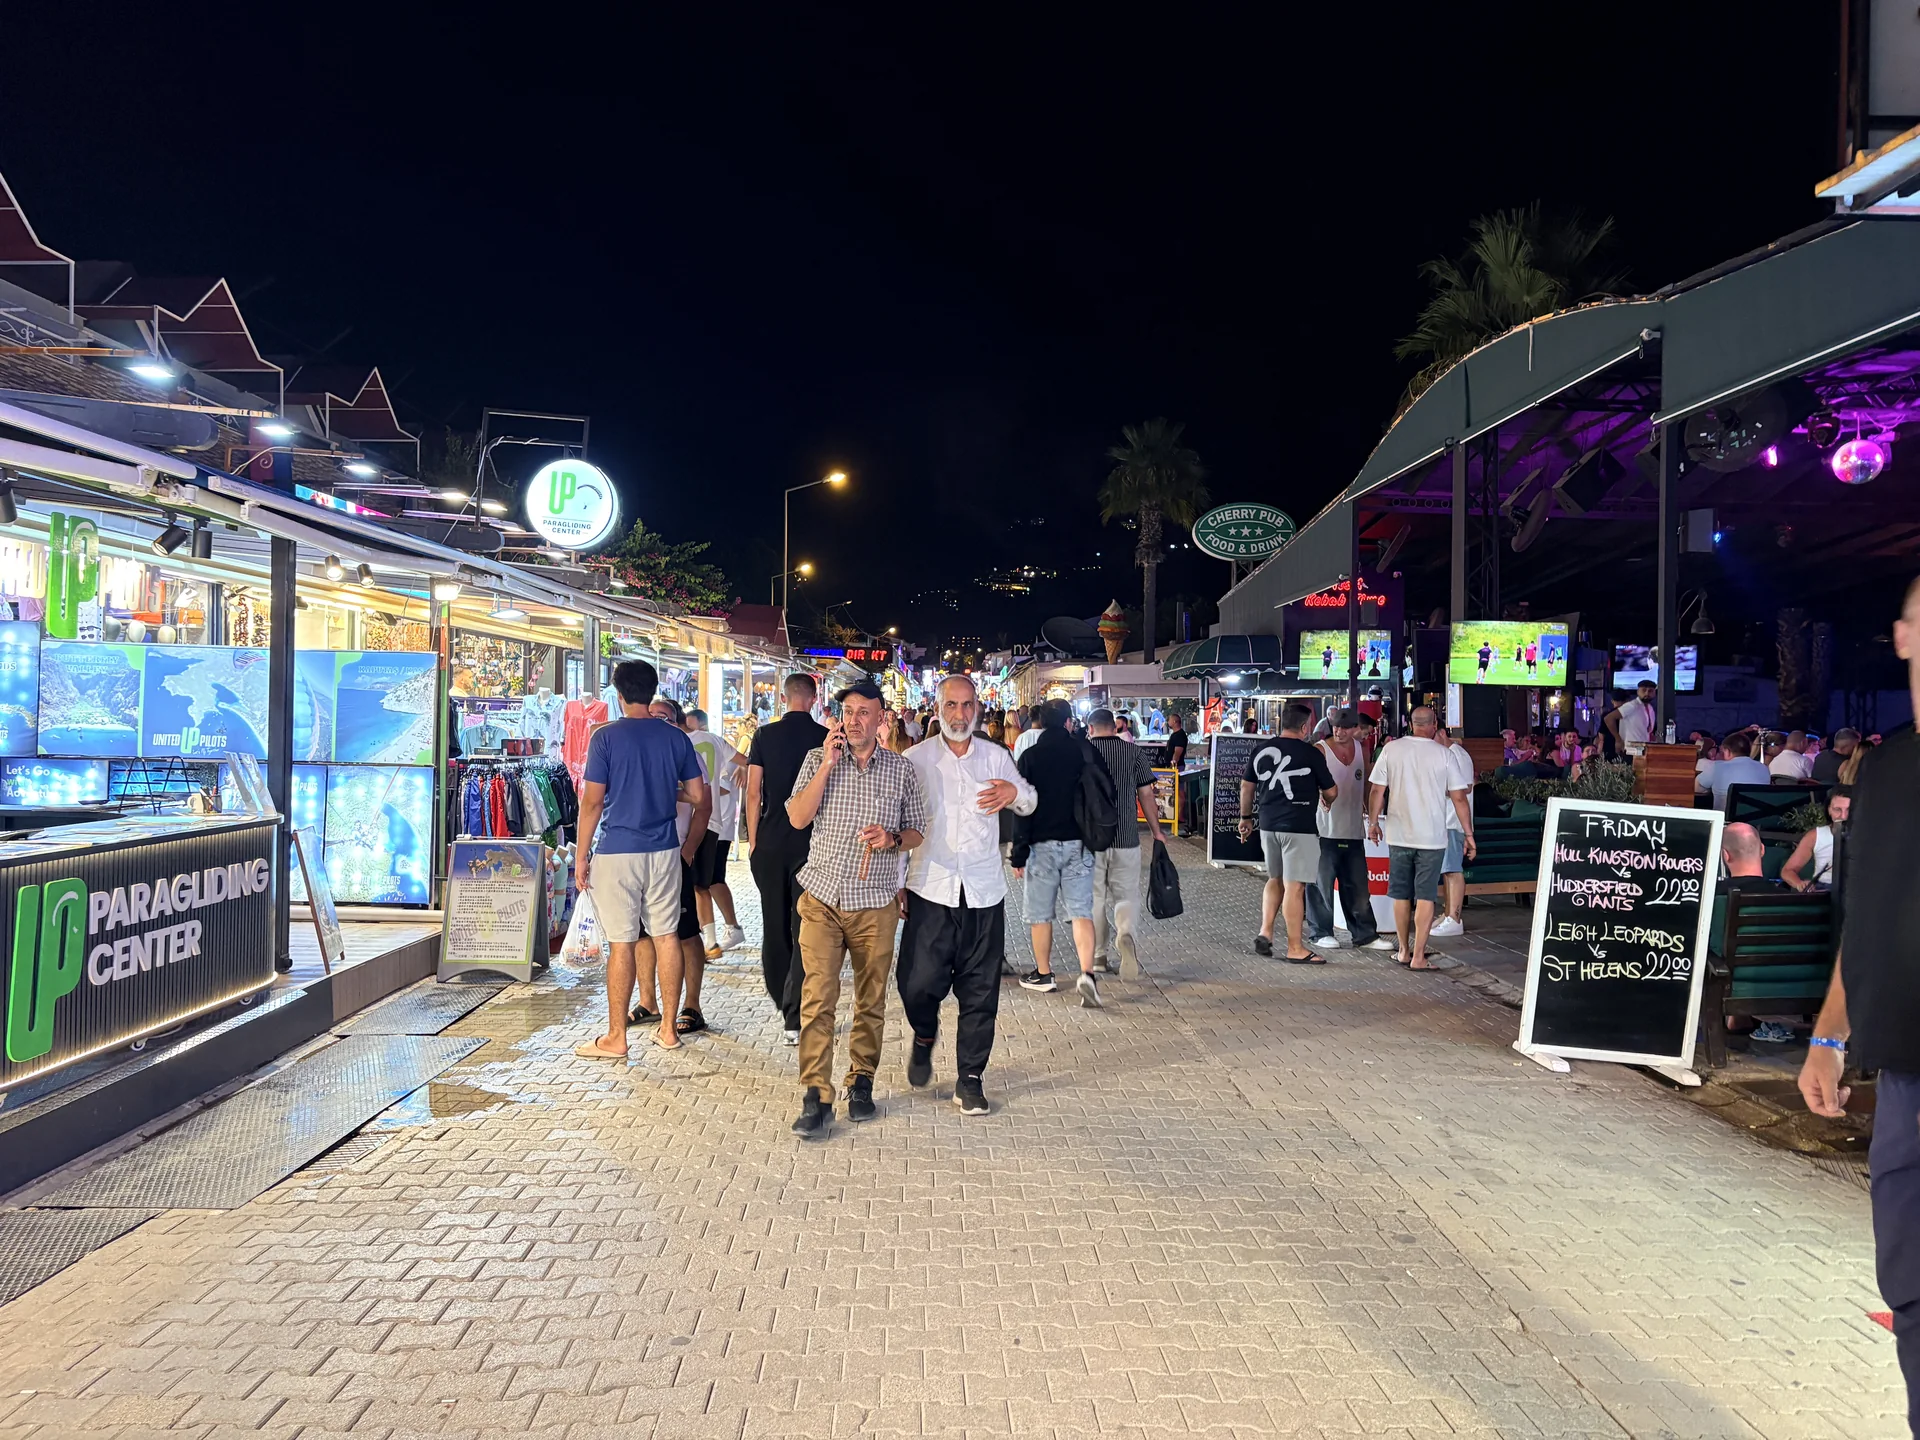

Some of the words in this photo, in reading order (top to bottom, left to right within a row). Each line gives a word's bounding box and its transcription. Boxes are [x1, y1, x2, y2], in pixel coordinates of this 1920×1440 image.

[548, 471, 577, 514] UP
[543, 520, 592, 529] PARAGLIDING
[1207, 508, 1256, 527] CHERRY
[1259, 510, 1284, 528] PUB
[1205, 533, 1235, 552] FOOD
[1238, 544, 1246, 553] &
[1250, 534, 1286, 553] DRINK
[1305, 593, 1346, 606] Kebab
[152, 733, 180, 746] UNITED
[200, 734, 228, 748] PILOTS
[1218, 737, 1258, 748] SATURDAY
[6, 764, 30, 776] Let's
[33, 765, 50, 776] Go
[1253, 746, 1312, 800] CK
[1579, 814, 1666, 850] FRIDAY
[1554, 842, 1585, 864] HULL
[1588, 846, 1656, 871] KINGSTON
[1657, 854, 1703, 874] ROVERS
[1368, 870, 1390, 881] bab
[88, 858, 270, 935] PARAGLIDING
[1572, 892, 1635, 911] GIANTS
[496, 899, 527, 920] PILOTS
[1544, 912, 1598, 942] LEIGH
[1600, 922, 1684, 952] LEOPARDS
[88, 920, 202, 986] CENTER
[7, 877, 88, 1062] UP
[1542, 954, 1576, 982] ST
[1580, 960, 1642, 981] HELENS
